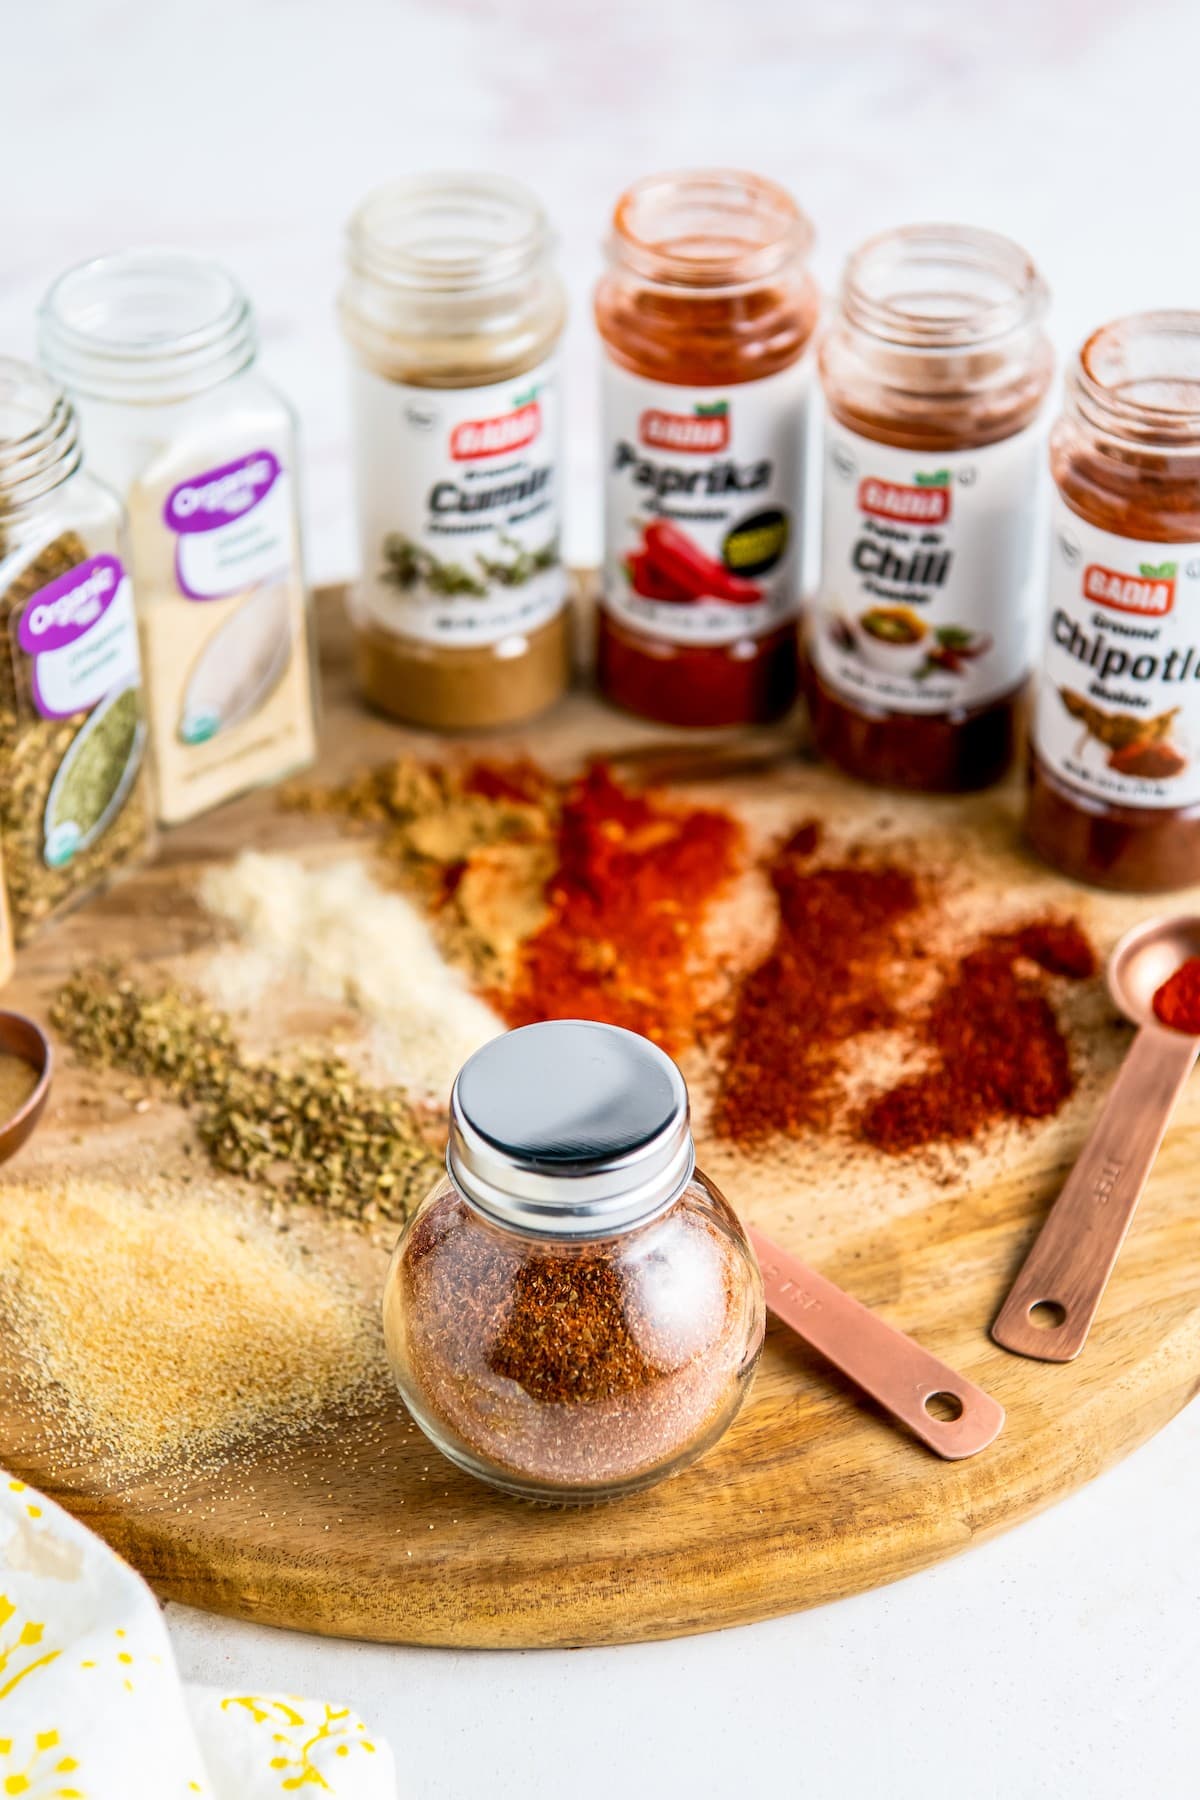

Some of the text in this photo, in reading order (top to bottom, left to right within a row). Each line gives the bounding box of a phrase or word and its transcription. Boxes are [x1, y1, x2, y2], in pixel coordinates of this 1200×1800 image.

[429, 466, 554, 513] Cumin
[613, 441, 772, 495] Paprika
[1087, 567, 1170, 612] BADIA
[1053, 607, 1200, 683] Chipotl
[779, 1277, 823, 1313] TSP
